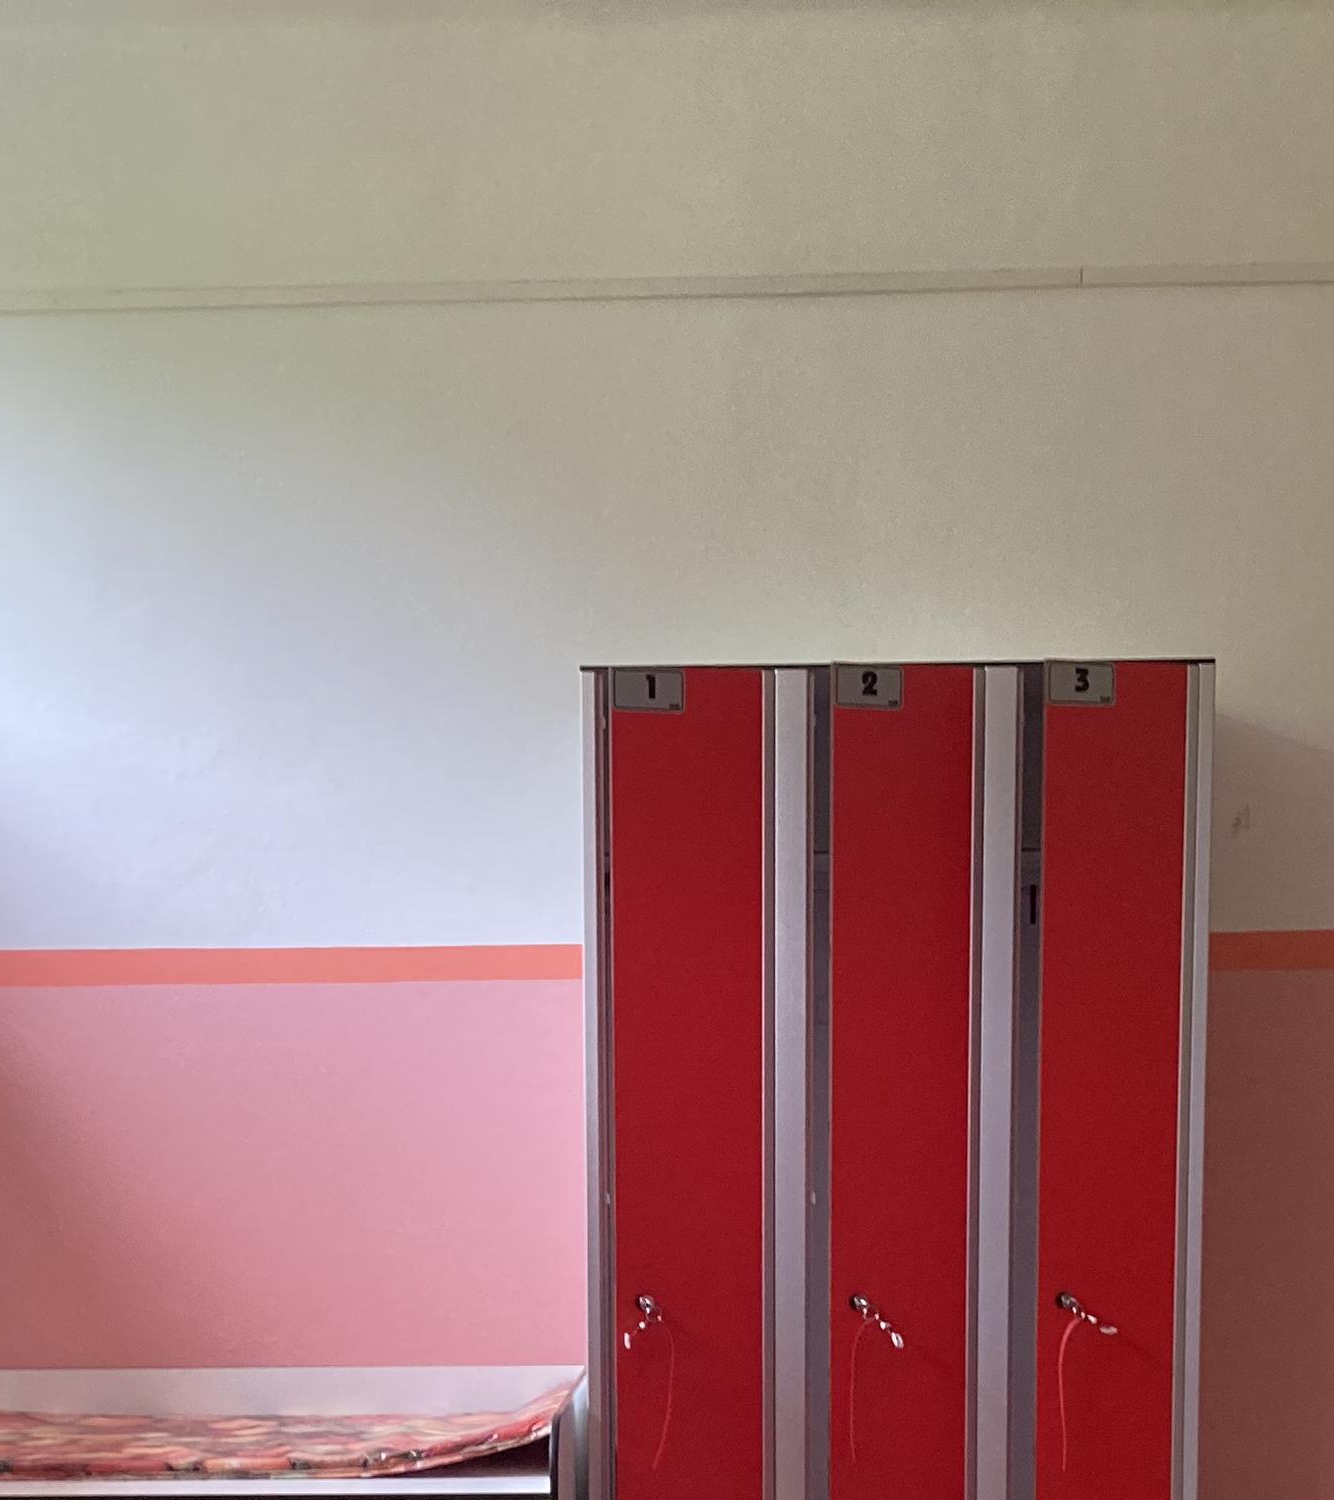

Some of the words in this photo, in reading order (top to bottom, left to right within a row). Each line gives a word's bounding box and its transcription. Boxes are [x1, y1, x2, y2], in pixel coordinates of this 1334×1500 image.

[645, 674, 656, 700] 1
[861, 670, 878, 697] 2
[1074, 666, 1090, 693] 3
